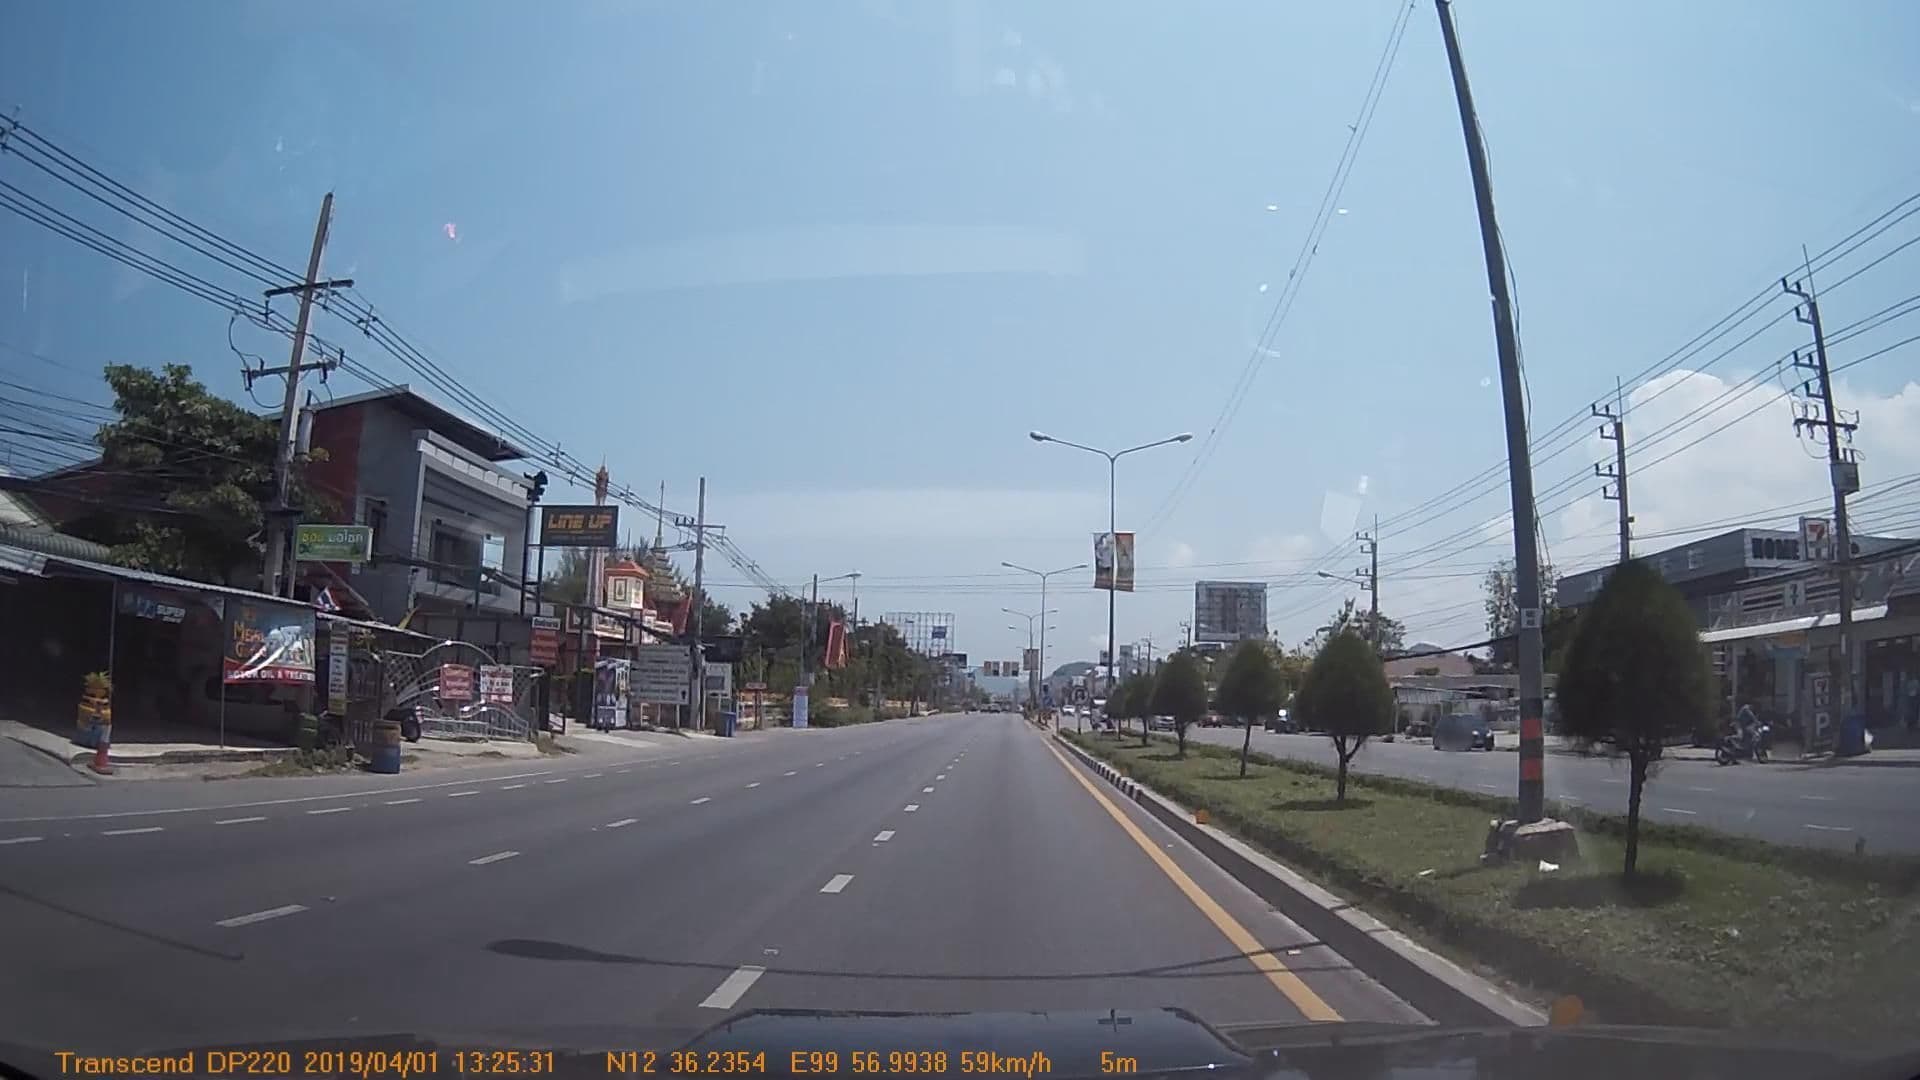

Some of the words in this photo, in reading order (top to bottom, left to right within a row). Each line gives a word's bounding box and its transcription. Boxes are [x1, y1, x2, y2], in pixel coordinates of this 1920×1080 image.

[548, 514, 585, 529] LINE
[588, 513, 613, 529] UP
[1816, 712, 1830, 737] P
